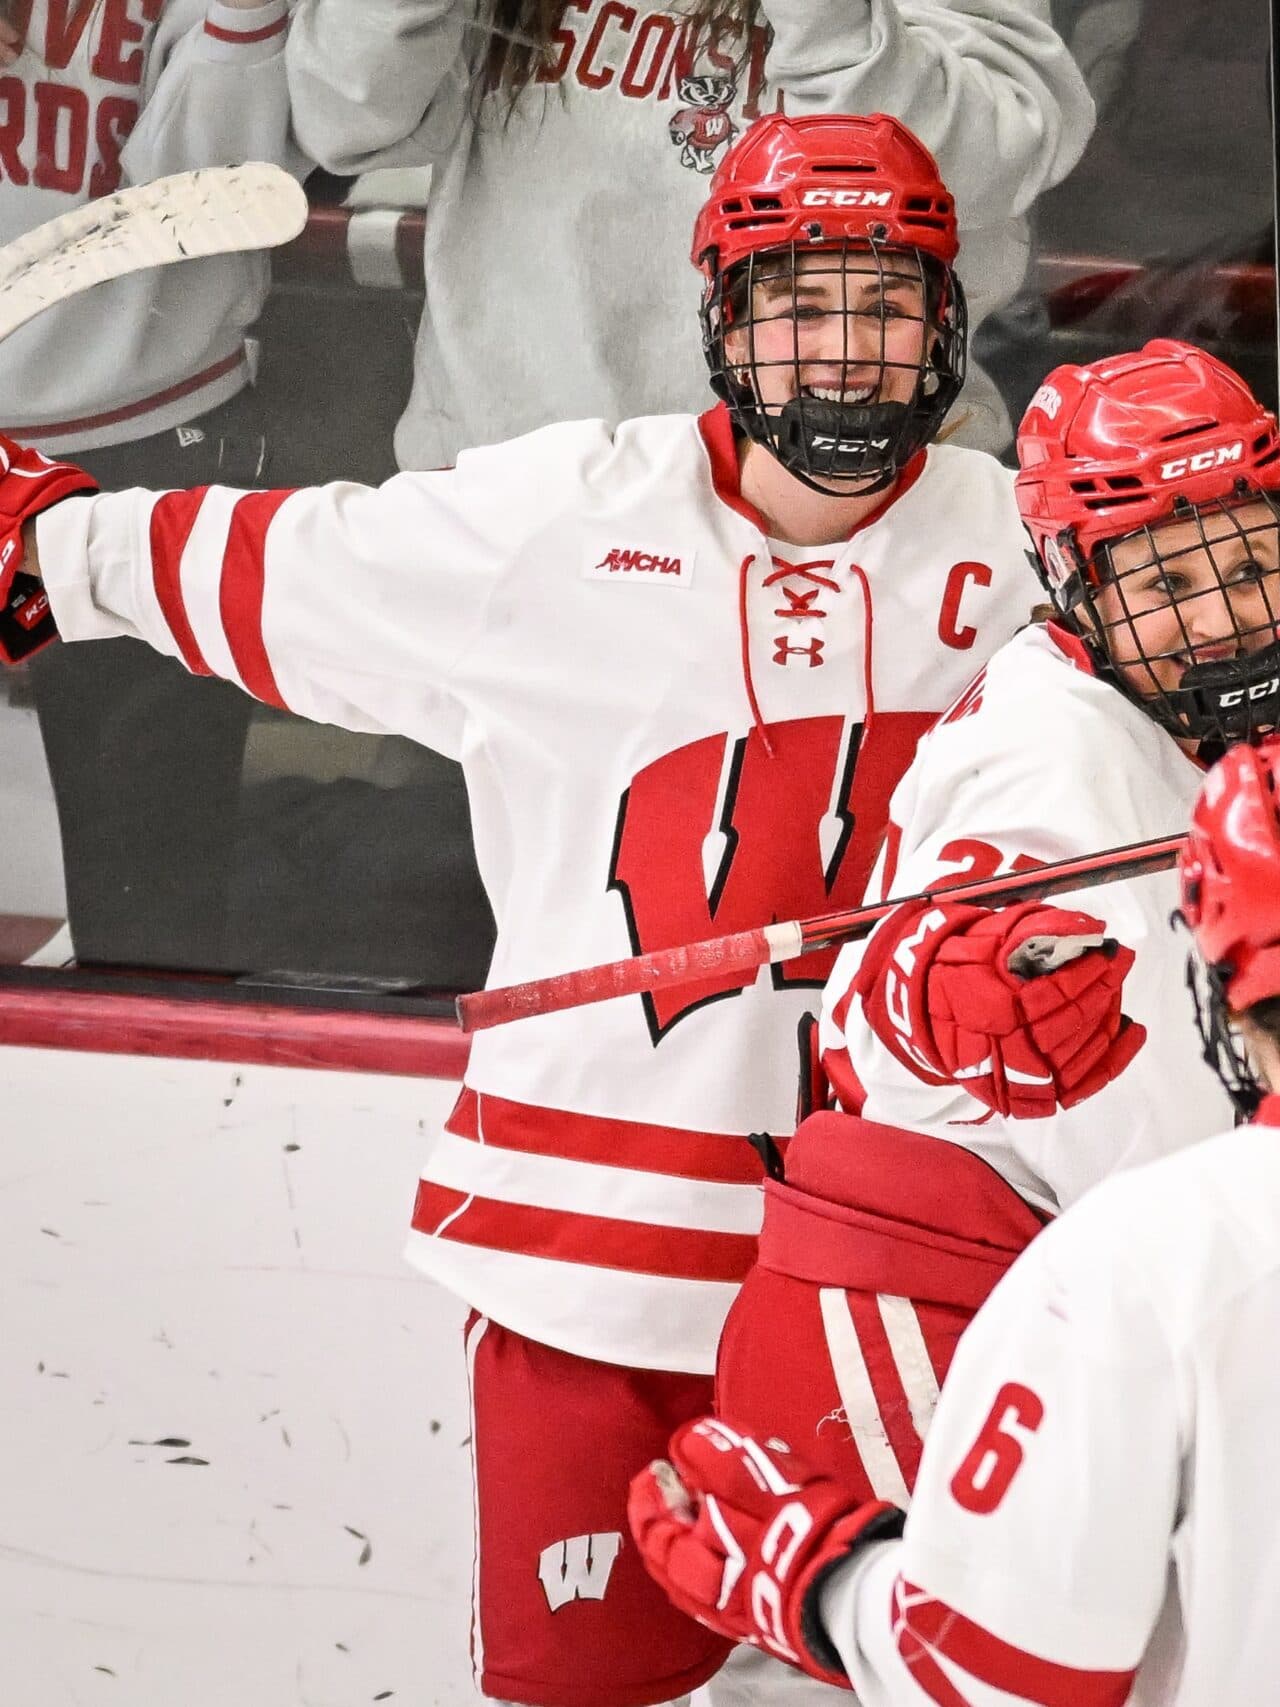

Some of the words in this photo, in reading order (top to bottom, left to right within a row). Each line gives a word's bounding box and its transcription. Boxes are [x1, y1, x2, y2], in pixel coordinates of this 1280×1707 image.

[802, 190, 893, 207] CCM
[1161, 442, 1242, 480] CCM
[937, 562, 992, 650] C
[950, 1381, 1044, 1514] 6
[538, 1530, 623, 1612] W
